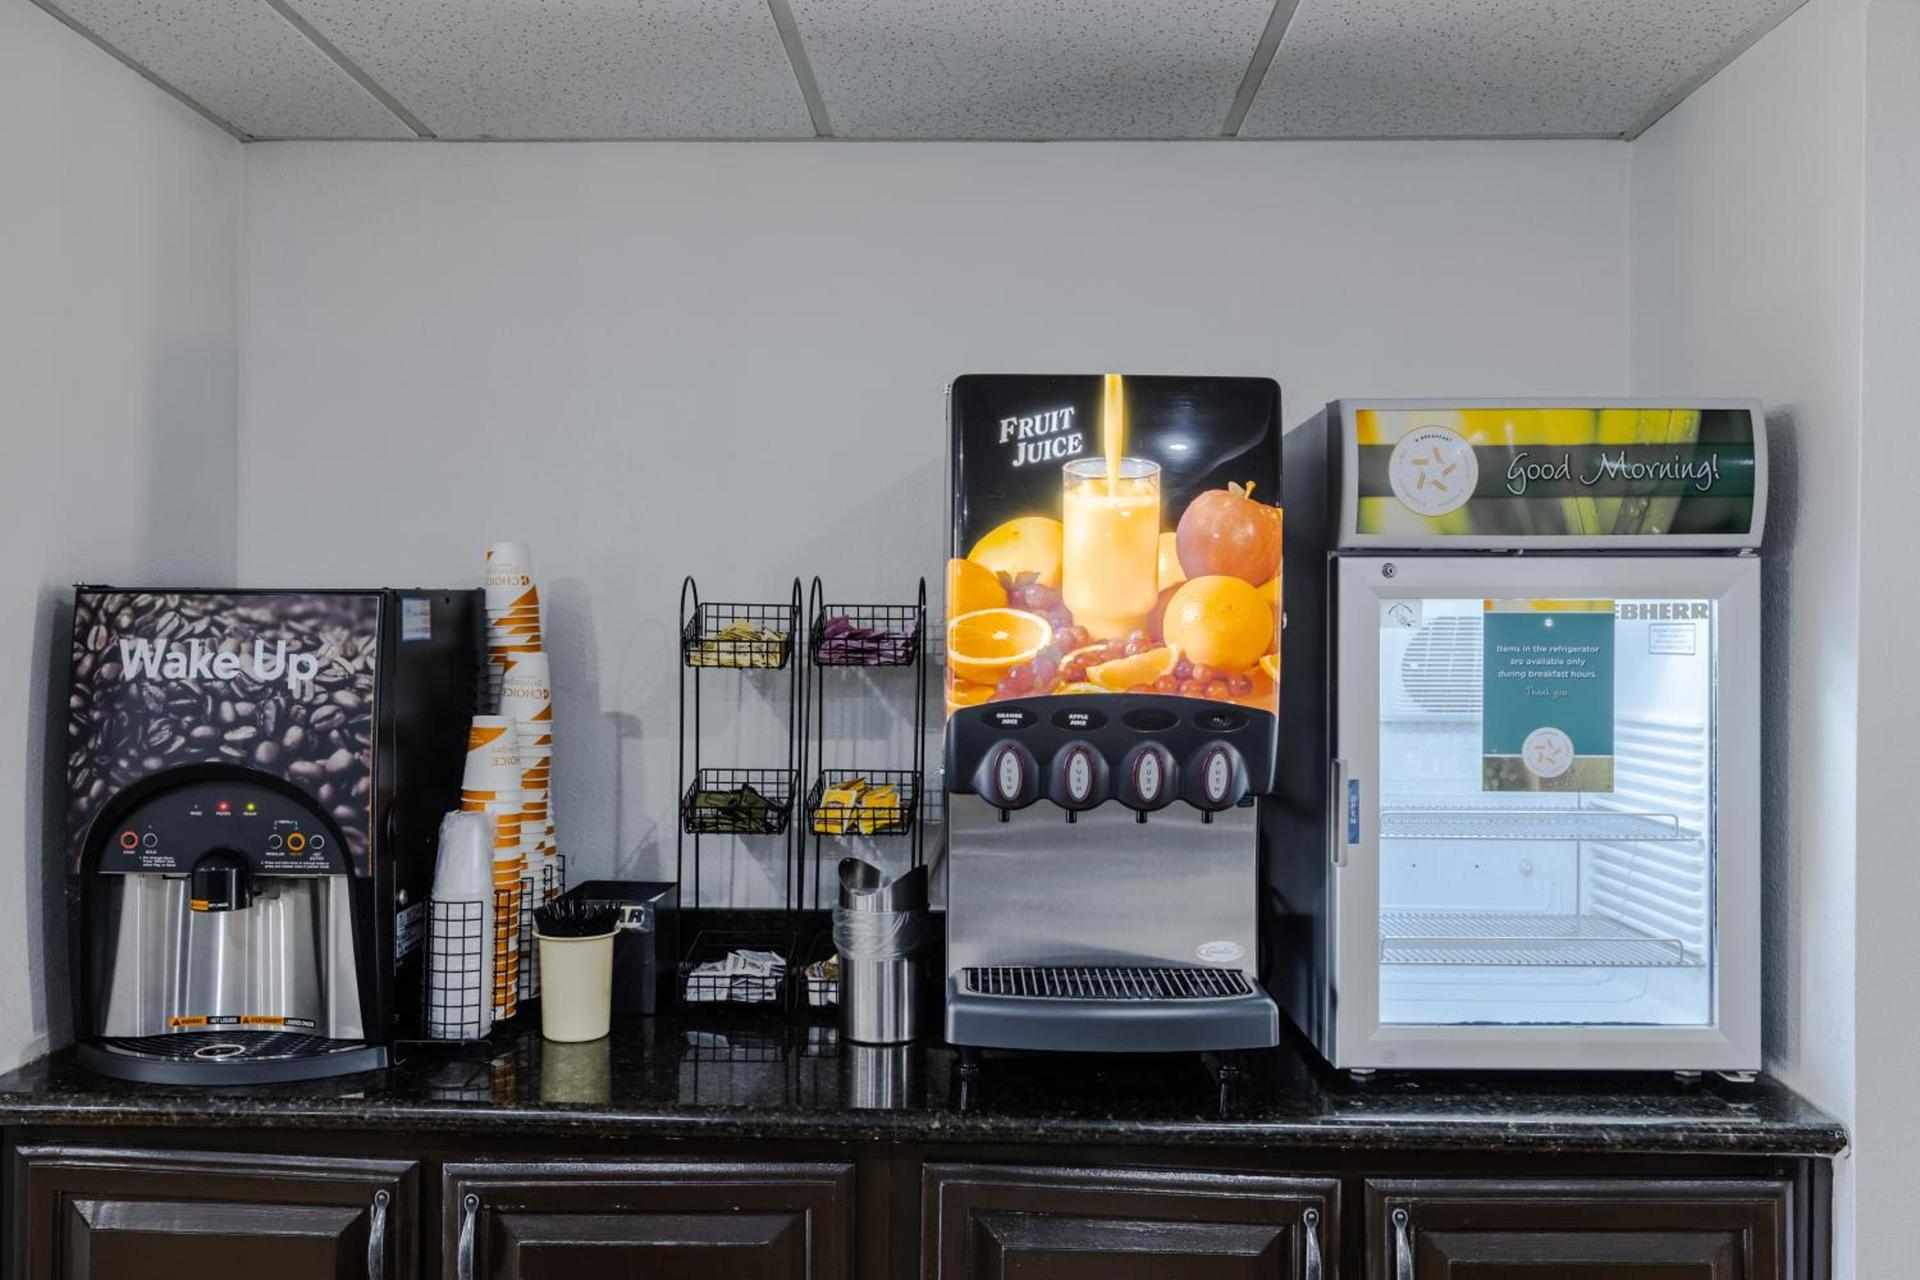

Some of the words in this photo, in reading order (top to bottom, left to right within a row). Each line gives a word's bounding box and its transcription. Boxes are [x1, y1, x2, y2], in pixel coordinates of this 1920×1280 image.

[999, 406, 1075, 443] FRUIT
[1012, 433, 1082, 467] JUICE
[1507, 452, 1571, 495] Good
[1579, 451, 1720, 491] Morning!
[119, 638, 240, 681] Wake
[253, 639, 319, 690] Up
[1497, 645, 1520, 653] Items
[1522, 645, 1531, 653] in
[1533, 645, 1547, 653] the
[1549, 645, 1600, 655] refrigerator
[1566, 658, 1586, 666] only
[1497, 671, 1526, 679] during
